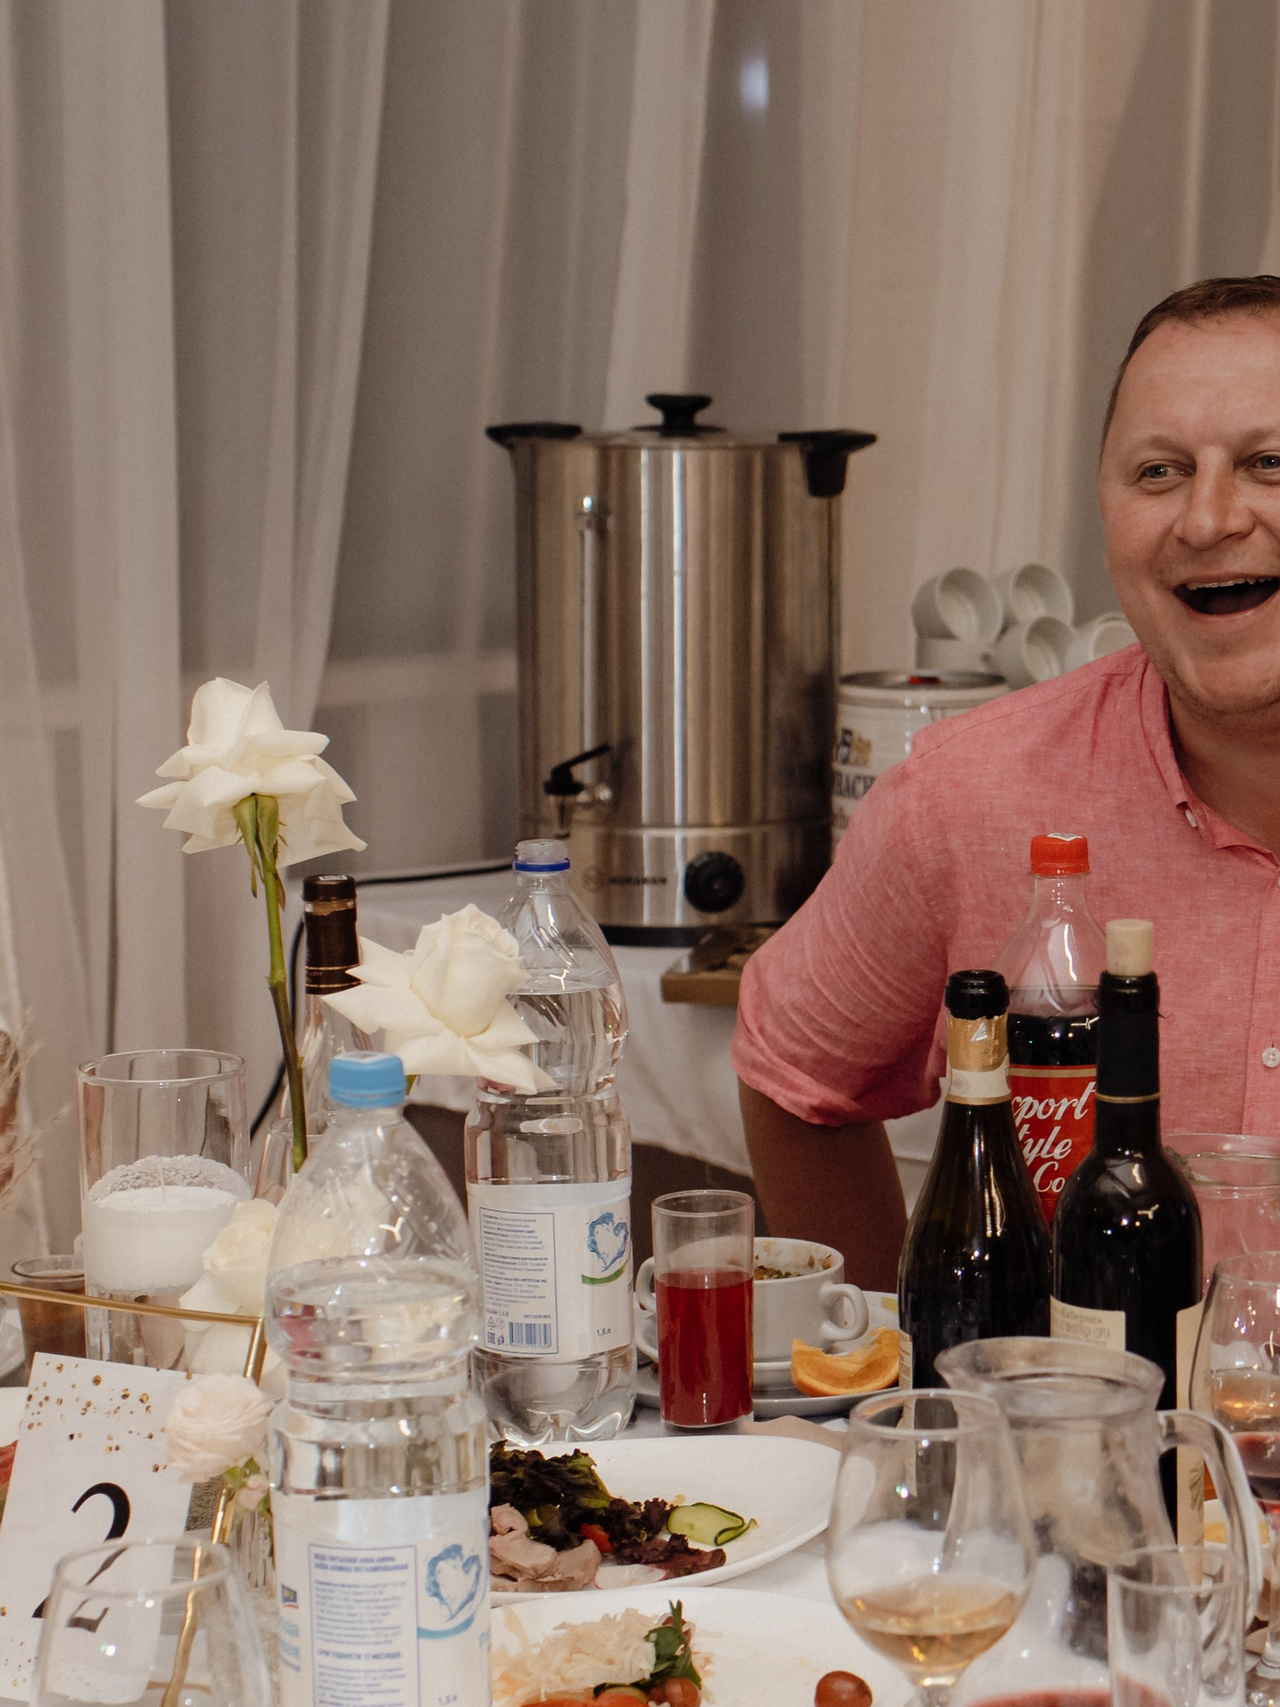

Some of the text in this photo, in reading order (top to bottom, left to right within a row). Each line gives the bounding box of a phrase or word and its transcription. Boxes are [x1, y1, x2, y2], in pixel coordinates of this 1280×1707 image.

[1018, 1124, 1072, 1167] tyle
[1033, 1161, 1065, 1192] Co
[31, 1481, 131, 1632] 2
